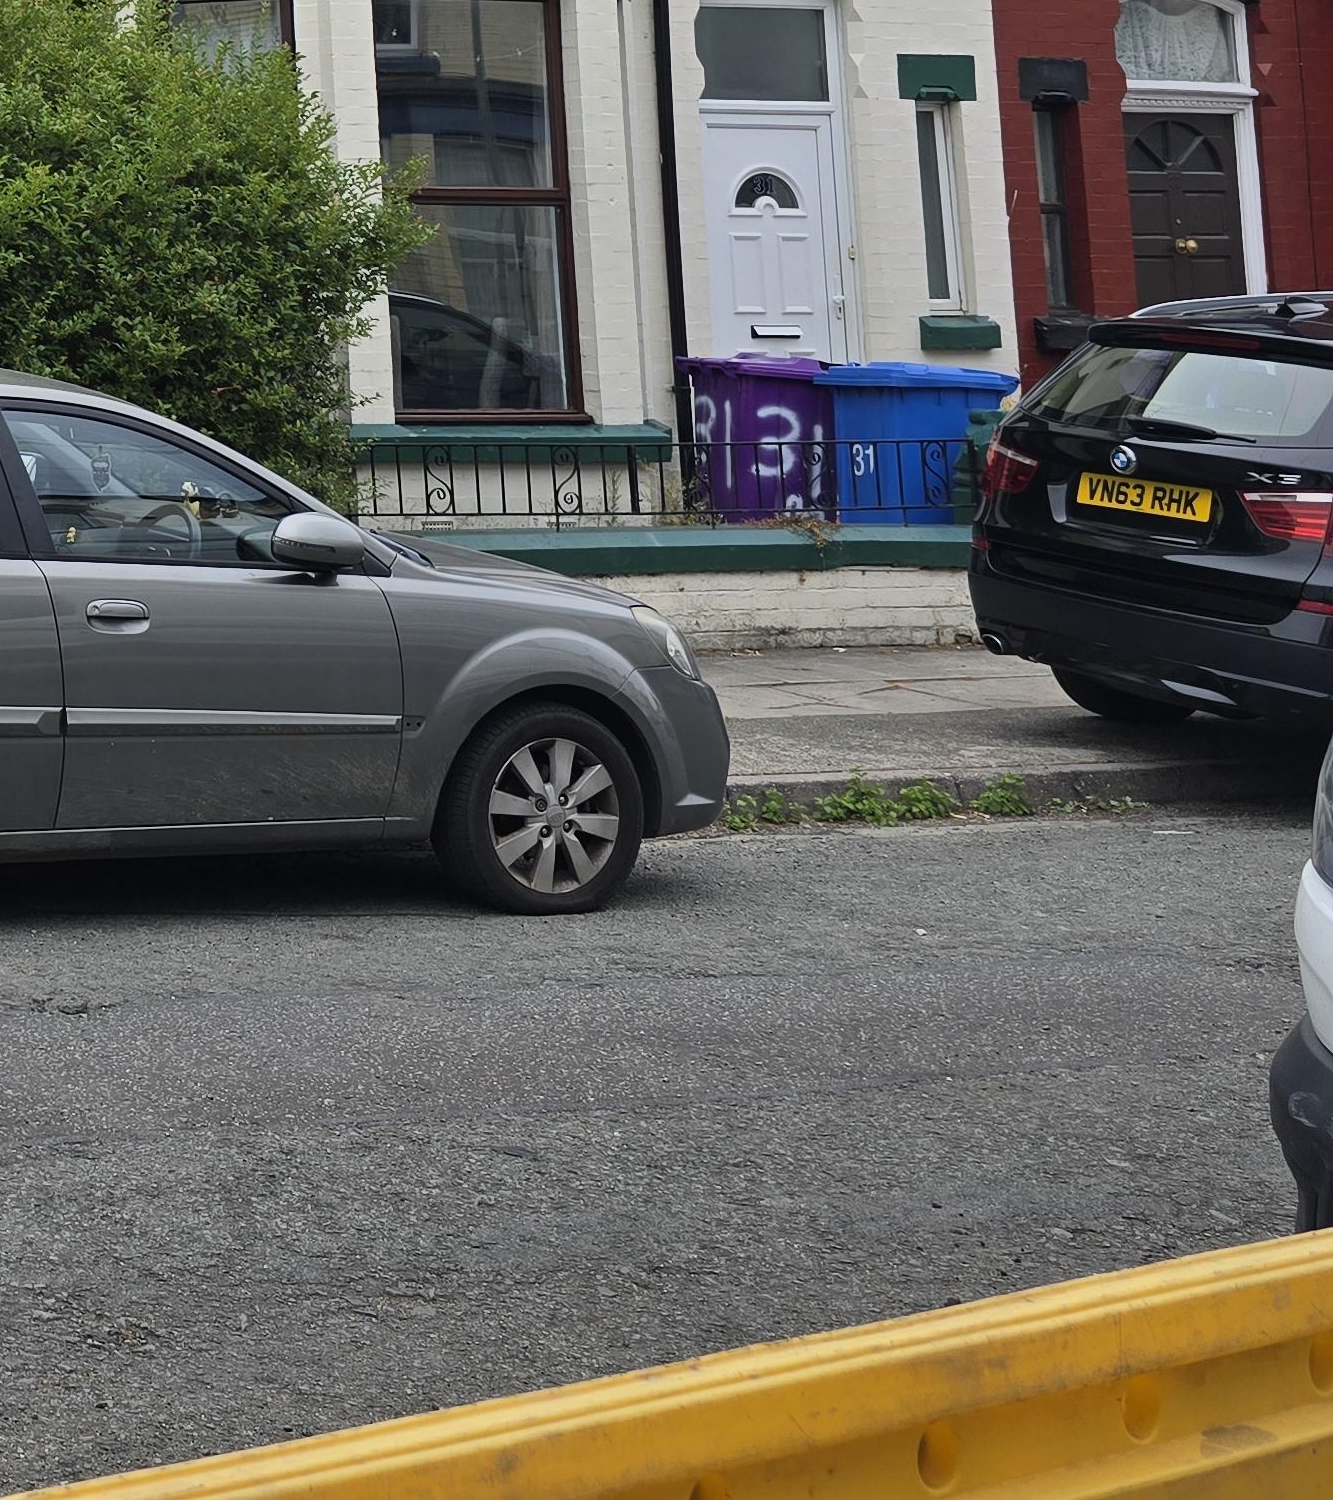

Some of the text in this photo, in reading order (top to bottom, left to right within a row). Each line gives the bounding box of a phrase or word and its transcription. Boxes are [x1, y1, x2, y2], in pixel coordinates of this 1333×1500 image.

[753, 176, 776, 195] 31
[852, 443, 875, 477] 31
[1244, 471, 1302, 485] X3
[1087, 477, 1200, 517] VN63 RHK
